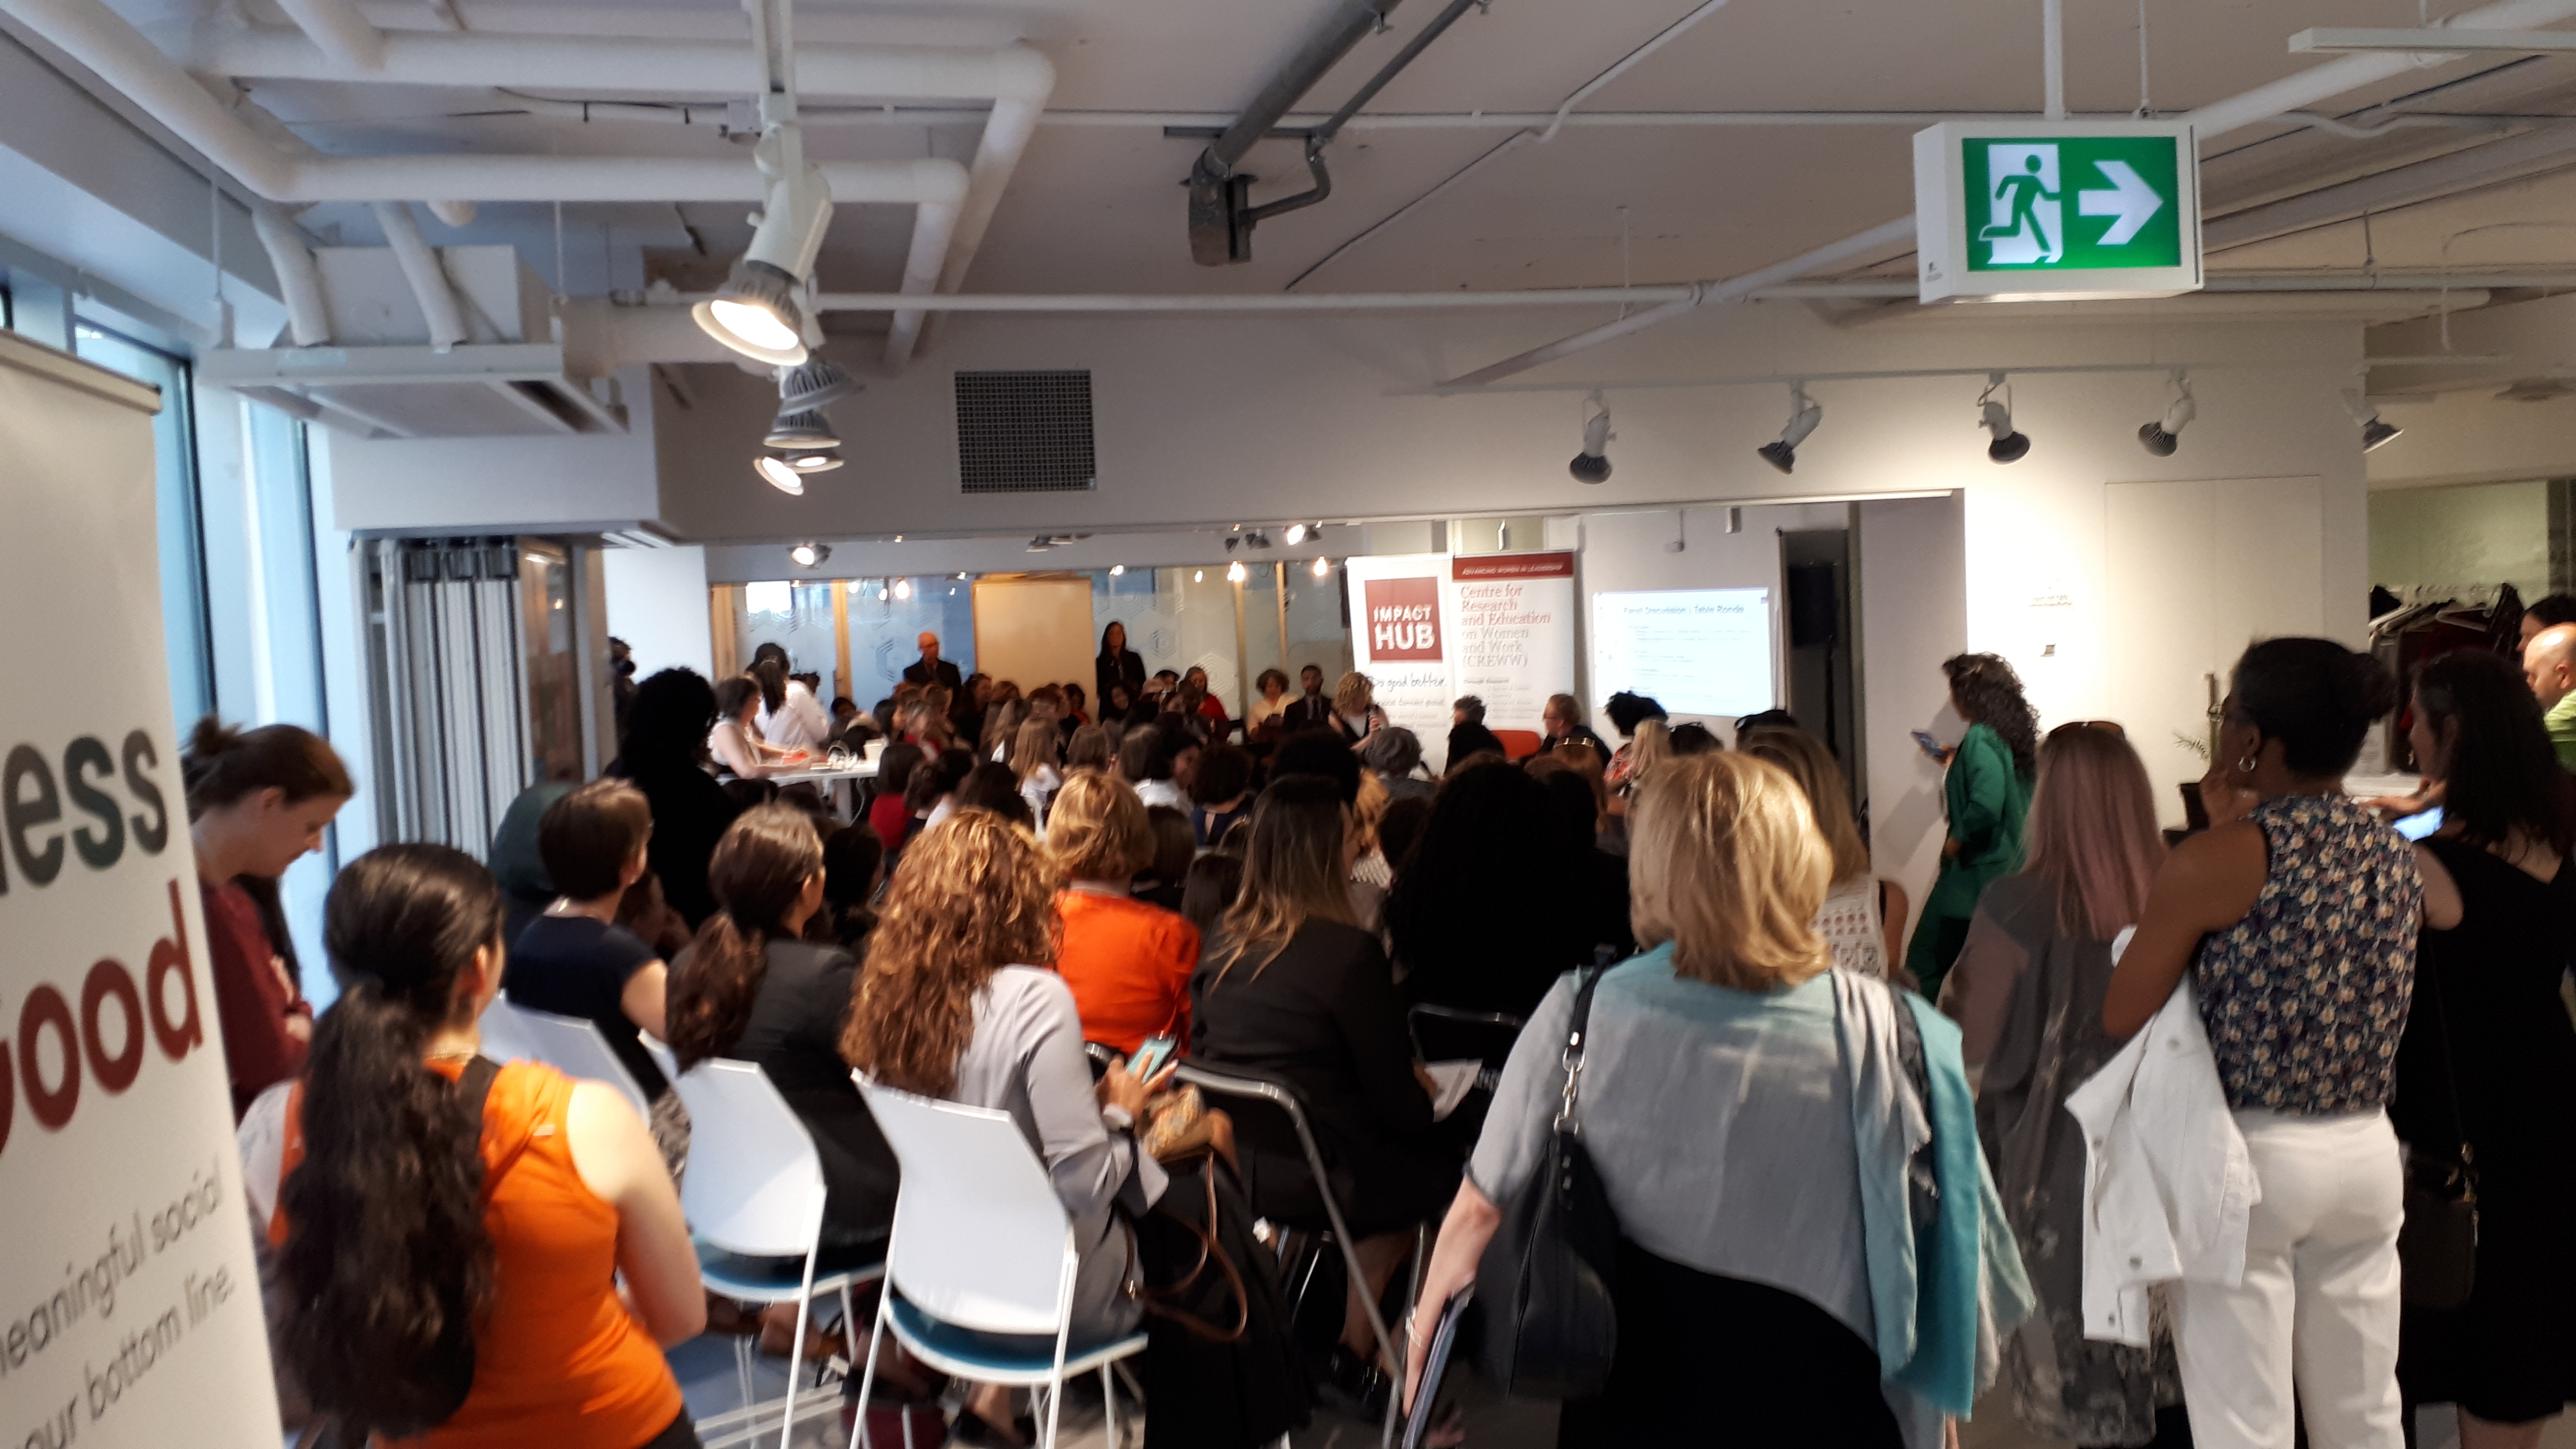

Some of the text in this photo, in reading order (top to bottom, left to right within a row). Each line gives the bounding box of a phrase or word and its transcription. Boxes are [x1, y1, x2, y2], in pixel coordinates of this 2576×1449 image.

[1461, 583, 1523, 599] Centre for
[1461, 598, 1518, 612] Research
[1716, 604, 1745, 614] Ronde
[1373, 604, 1432, 622] IMPACT
[1461, 611, 1551, 626] and Education
[1374, 621, 1436, 651] HUB
[1462, 627, 1529, 640] on Women
[1462, 641, 1523, 654] and Work
[1463, 654, 1528, 667] (CREWW)
[0, 728, 169, 892] ess
[151, 1154, 223, 1254] social
[84, 1305, 182, 1422] bottom
